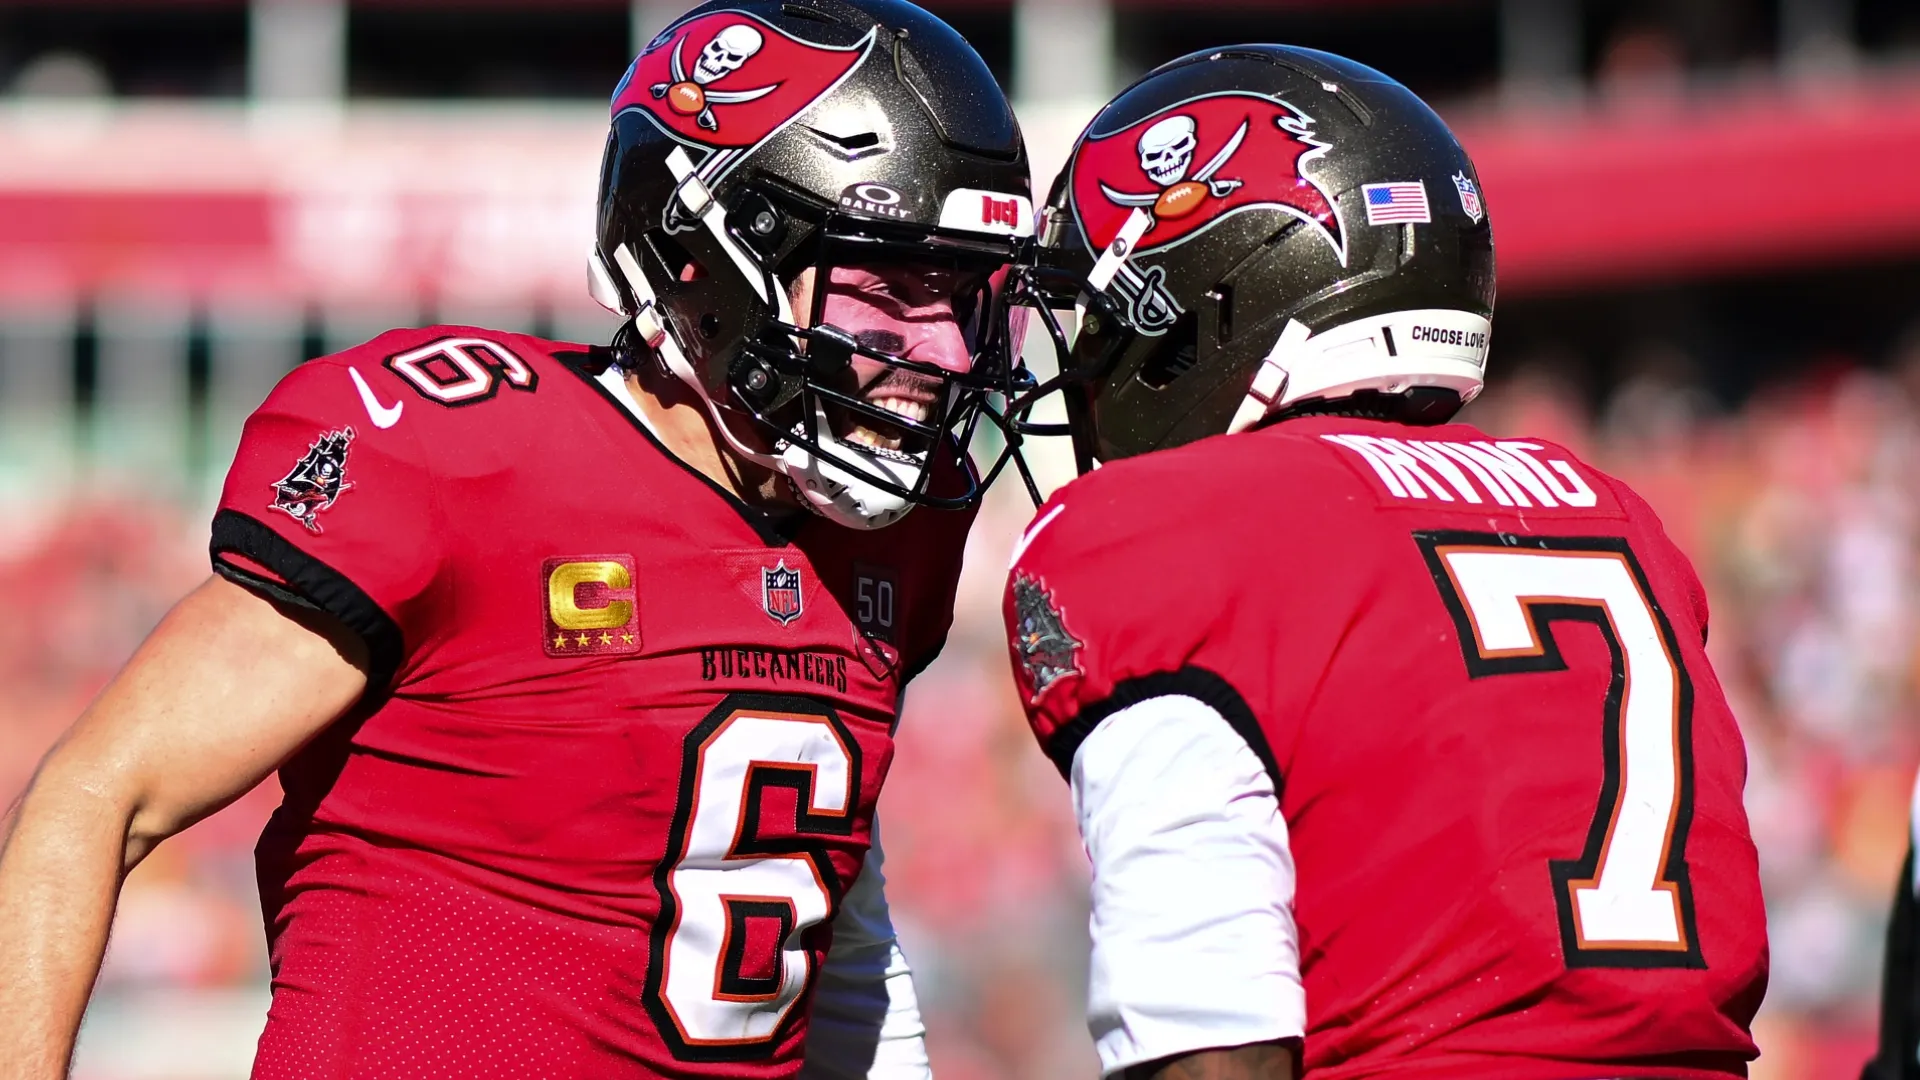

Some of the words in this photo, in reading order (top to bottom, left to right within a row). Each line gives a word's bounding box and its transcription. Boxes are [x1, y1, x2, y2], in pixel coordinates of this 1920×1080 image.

[842, 197, 910, 219] OAKLEY
[1462, 193, 1480, 214] NFL
[1412, 325, 1462, 345] CHOOSE
[1465, 331, 1485, 348] LOVE
[381, 335, 539, 408] 6
[1320, 434, 1597, 507] IRVING
[549, 561, 632, 629] C
[769, 589, 798, 614] NFL
[858, 577, 893, 627] 50
[702, 650, 847, 694] BUCCANEERS
[1411, 529, 1708, 970] 7
[641, 692, 863, 1062] 6
